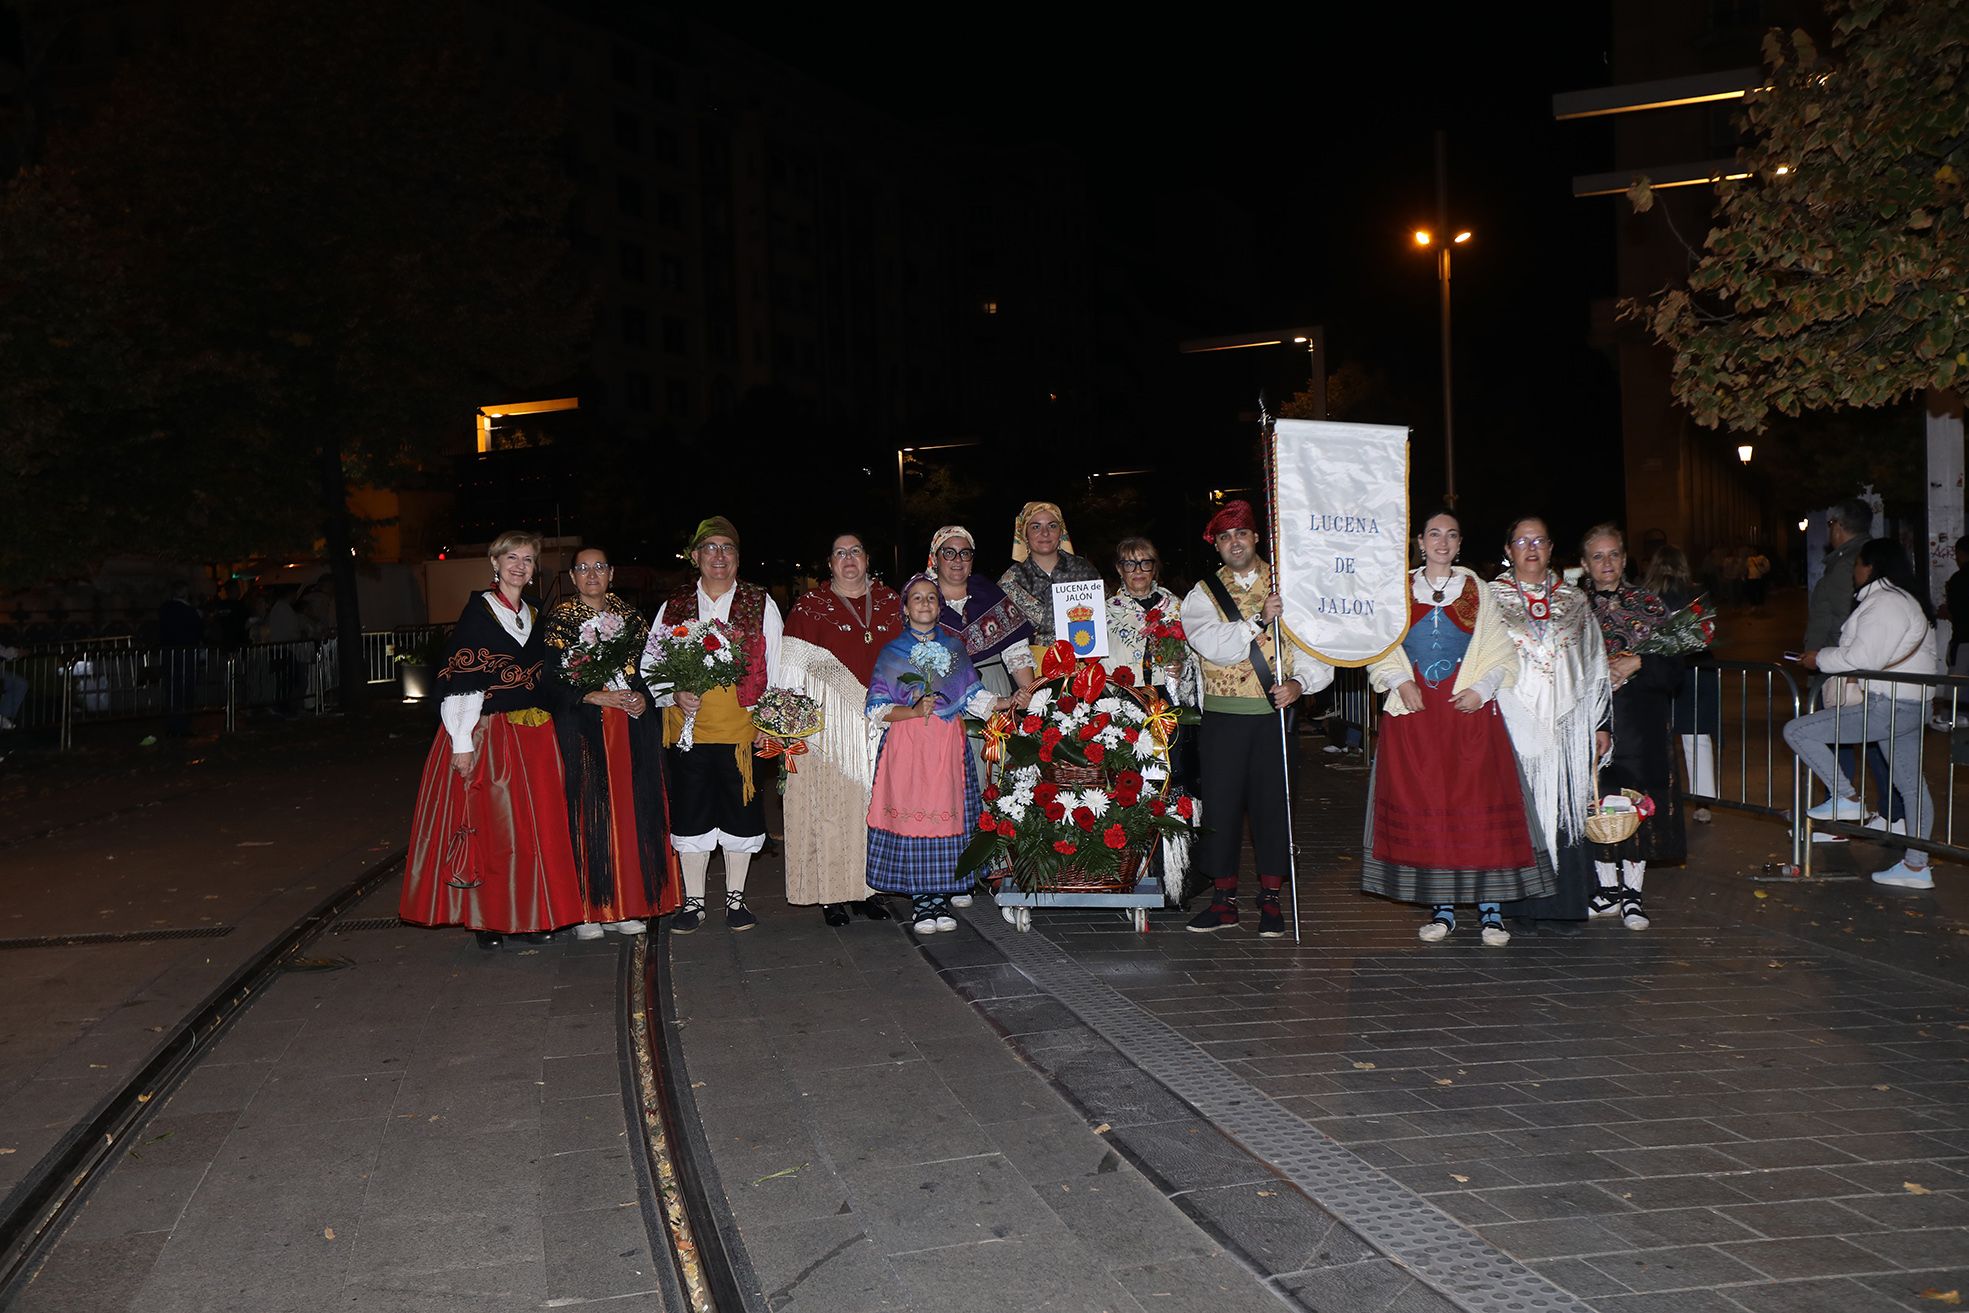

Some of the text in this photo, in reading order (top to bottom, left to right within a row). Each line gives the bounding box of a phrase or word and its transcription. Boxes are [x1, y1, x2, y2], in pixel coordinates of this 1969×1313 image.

[1310, 514, 1379, 533] LUCENA
[1335, 557, 1355, 574] DE
[1055, 582, 1102, 594] LUCENA de
[1318, 597, 1375, 615] JALON
